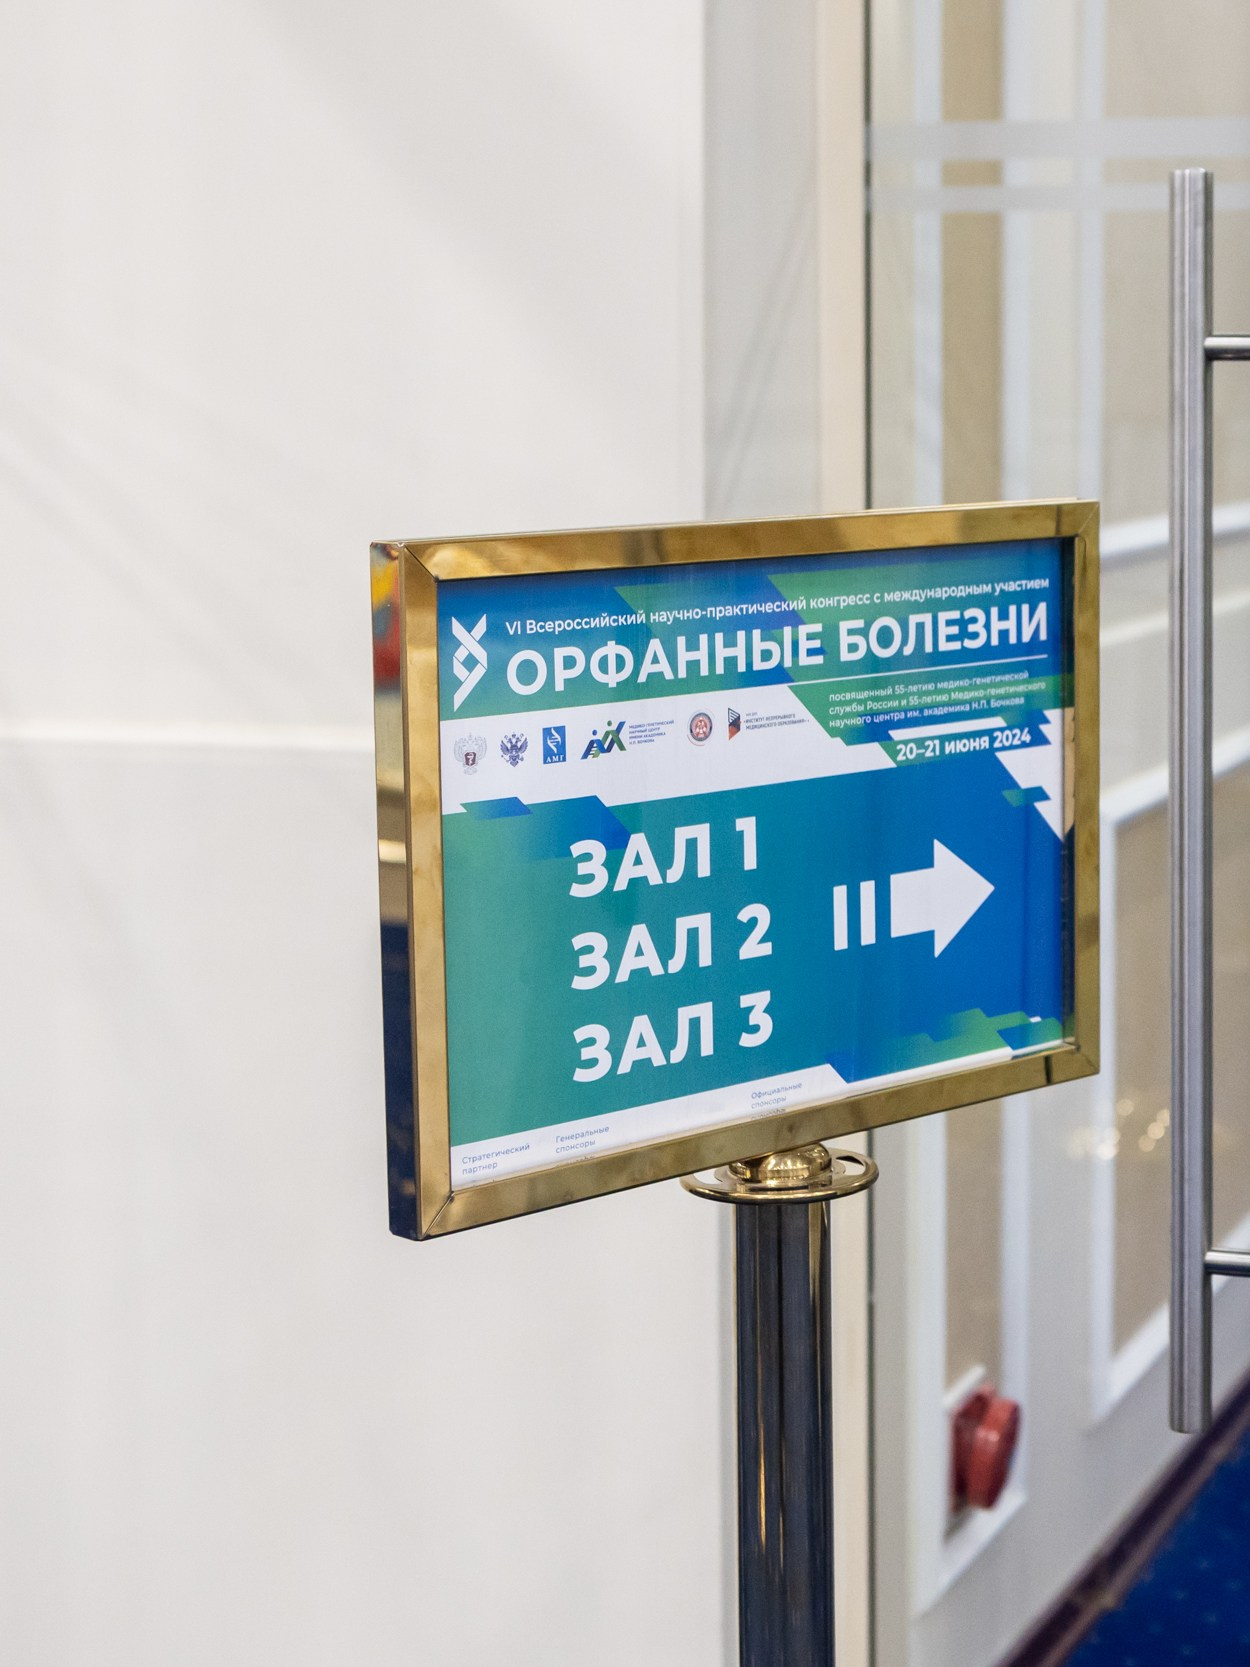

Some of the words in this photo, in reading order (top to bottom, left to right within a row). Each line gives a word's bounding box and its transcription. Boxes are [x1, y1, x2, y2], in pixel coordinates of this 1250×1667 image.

[505, 621, 522, 636] VI
[526, 610, 647, 634] Всероссийский
[650, 595, 807, 624] научно-практический
[810, 594, 871, 610] конгресс
[873, 593, 881, 603] с
[884, 581, 992, 603] международным
[994, 577, 1050, 596] участием
[506, 623, 824, 696] ОРФАННЫЕ
[839, 601, 1048, 662] БОЛЕЗНИ
[829, 687, 892, 702] посвященный
[894, 680, 936, 695] 55-летию
[937, 671, 1029, 691] медико-генетической
[829, 701, 865, 716] службы
[866, 698, 899, 711] России
[901, 698, 908, 706] и
[908, 692, 949, 706] 55-летию
[951, 682, 1046, 700] Медико-генетического
[829, 714, 872, 729] научного
[873, 711, 905, 724] центра
[907, 709, 922, 719] им.
[923, 701, 970, 716] академика
[972, 698, 988, 711] Н.П.
[991, 696, 1025, 708] Бочкова
[944, 734, 990, 754] июня
[994, 727, 1032, 748] 2024
[546, 754, 565, 764] АМГ
[570, 823, 711, 898] ЗАЛ
[735, 816, 757, 871] 1
[571, 912, 712, 991] ЗАЛ
[736, 903, 773, 960] 2
[572, 1001, 714, 1083] ЗАЛ
[738, 990, 773, 1048] 3
[751, 1083, 803, 1099] Официальные
[751, 1096, 787, 1110] спонсоры
[555, 1125, 610, 1144] Генеральные
[555, 1139, 597, 1155] спонсоры
[461, 1142, 531, 1165] Стратегический
[461, 1161, 499, 1176] партнер
